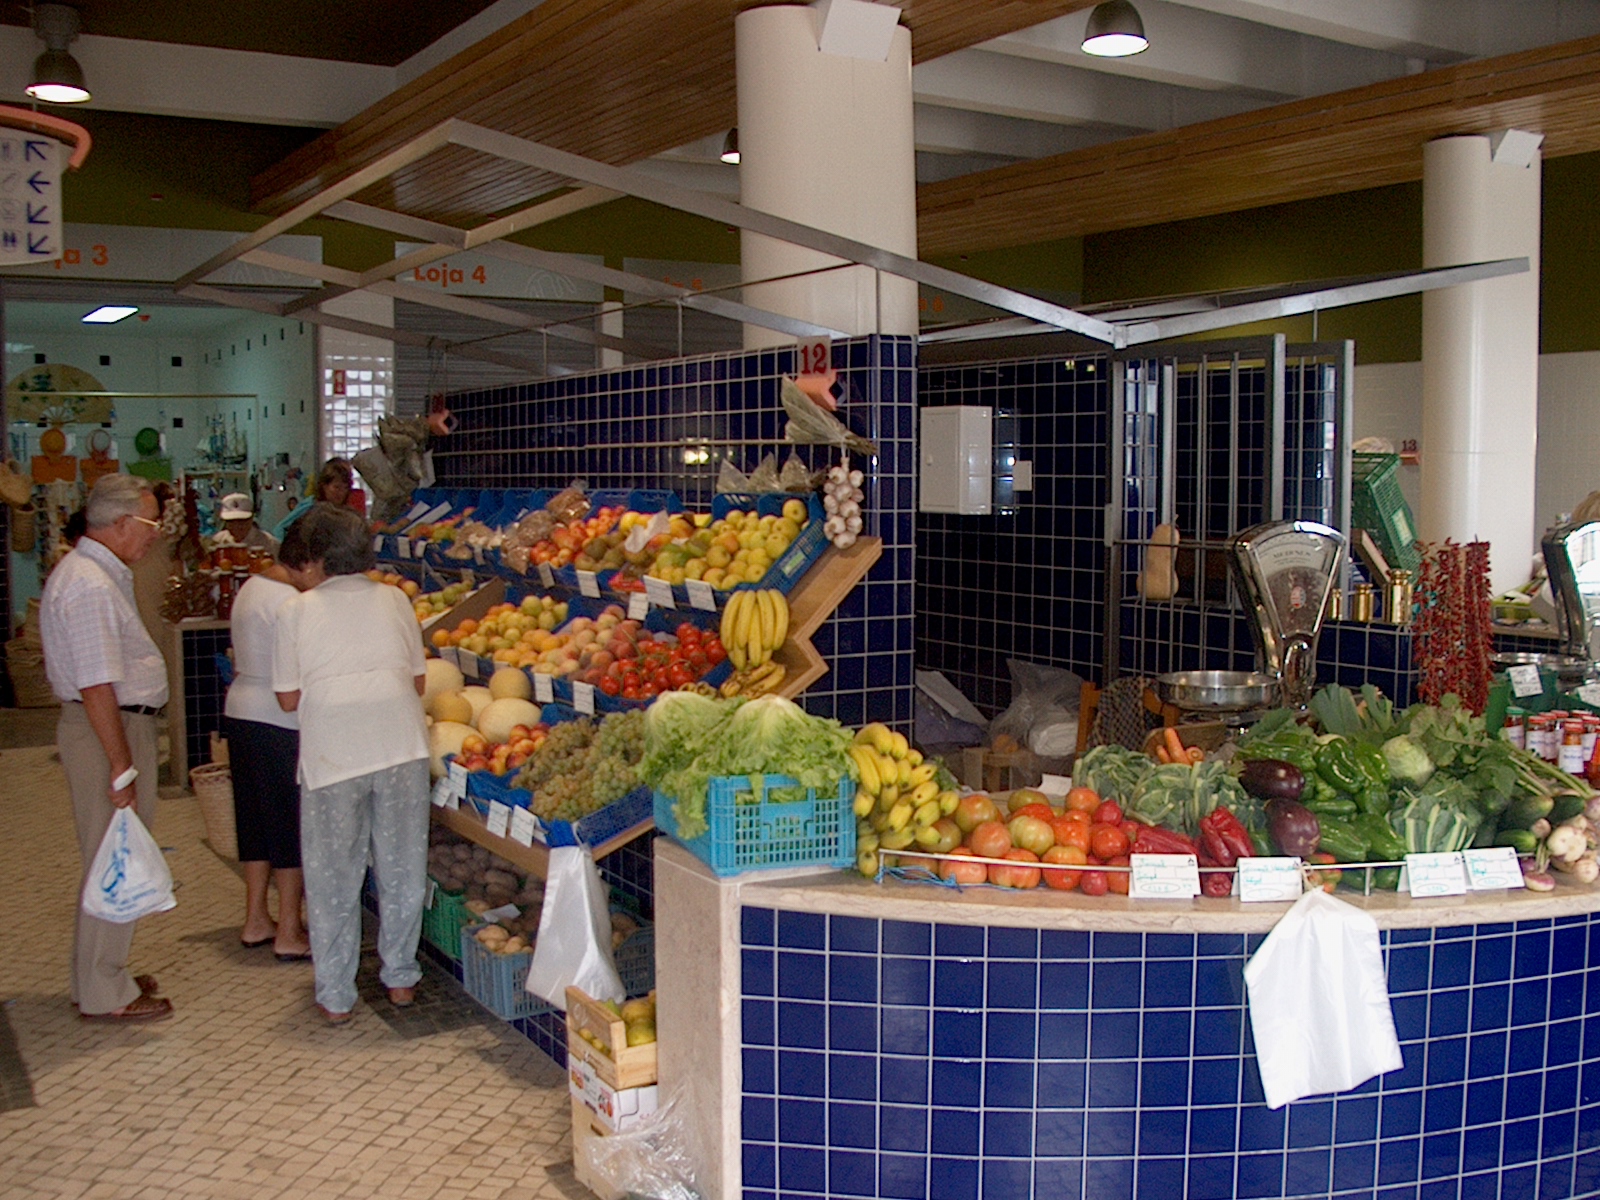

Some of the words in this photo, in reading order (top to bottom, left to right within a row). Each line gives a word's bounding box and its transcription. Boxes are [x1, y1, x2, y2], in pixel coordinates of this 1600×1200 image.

[92, 243, 108, 266] 3
[414, 263, 463, 287] Loja
[472, 266, 487, 284] 4
[801, 343, 827, 374] 12
[1402, 438, 1417, 452] 13
